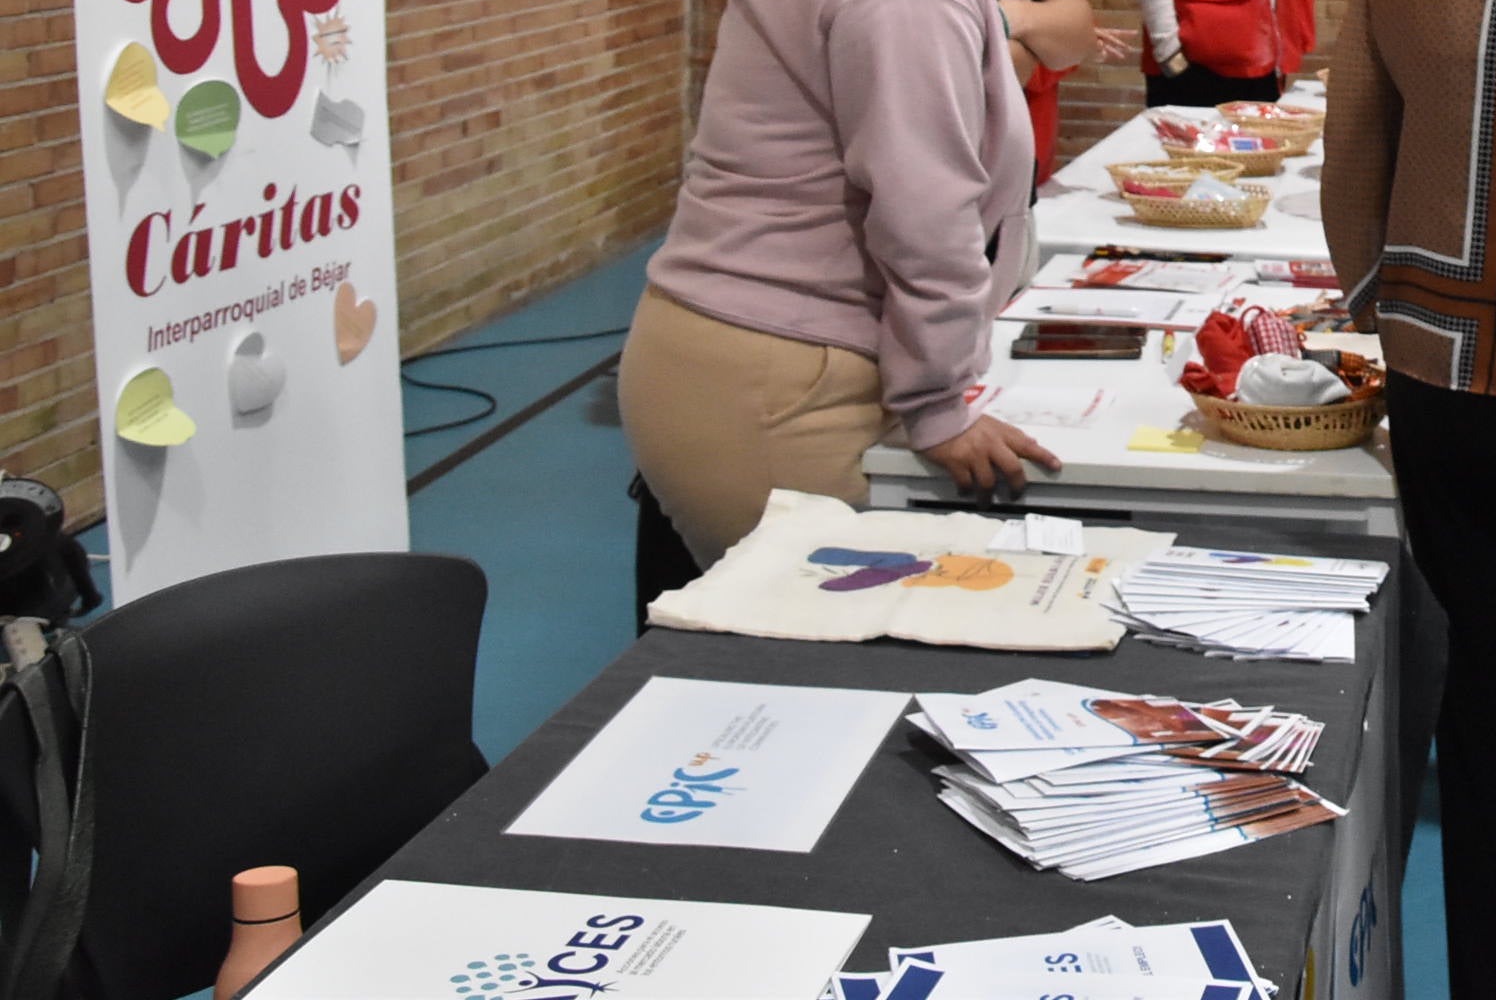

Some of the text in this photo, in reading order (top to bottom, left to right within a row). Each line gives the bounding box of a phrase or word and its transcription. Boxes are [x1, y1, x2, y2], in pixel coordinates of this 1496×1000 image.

[125, 182, 361, 297] Cáritas
[147, 262, 352, 353] Interparroquial de Béjar
